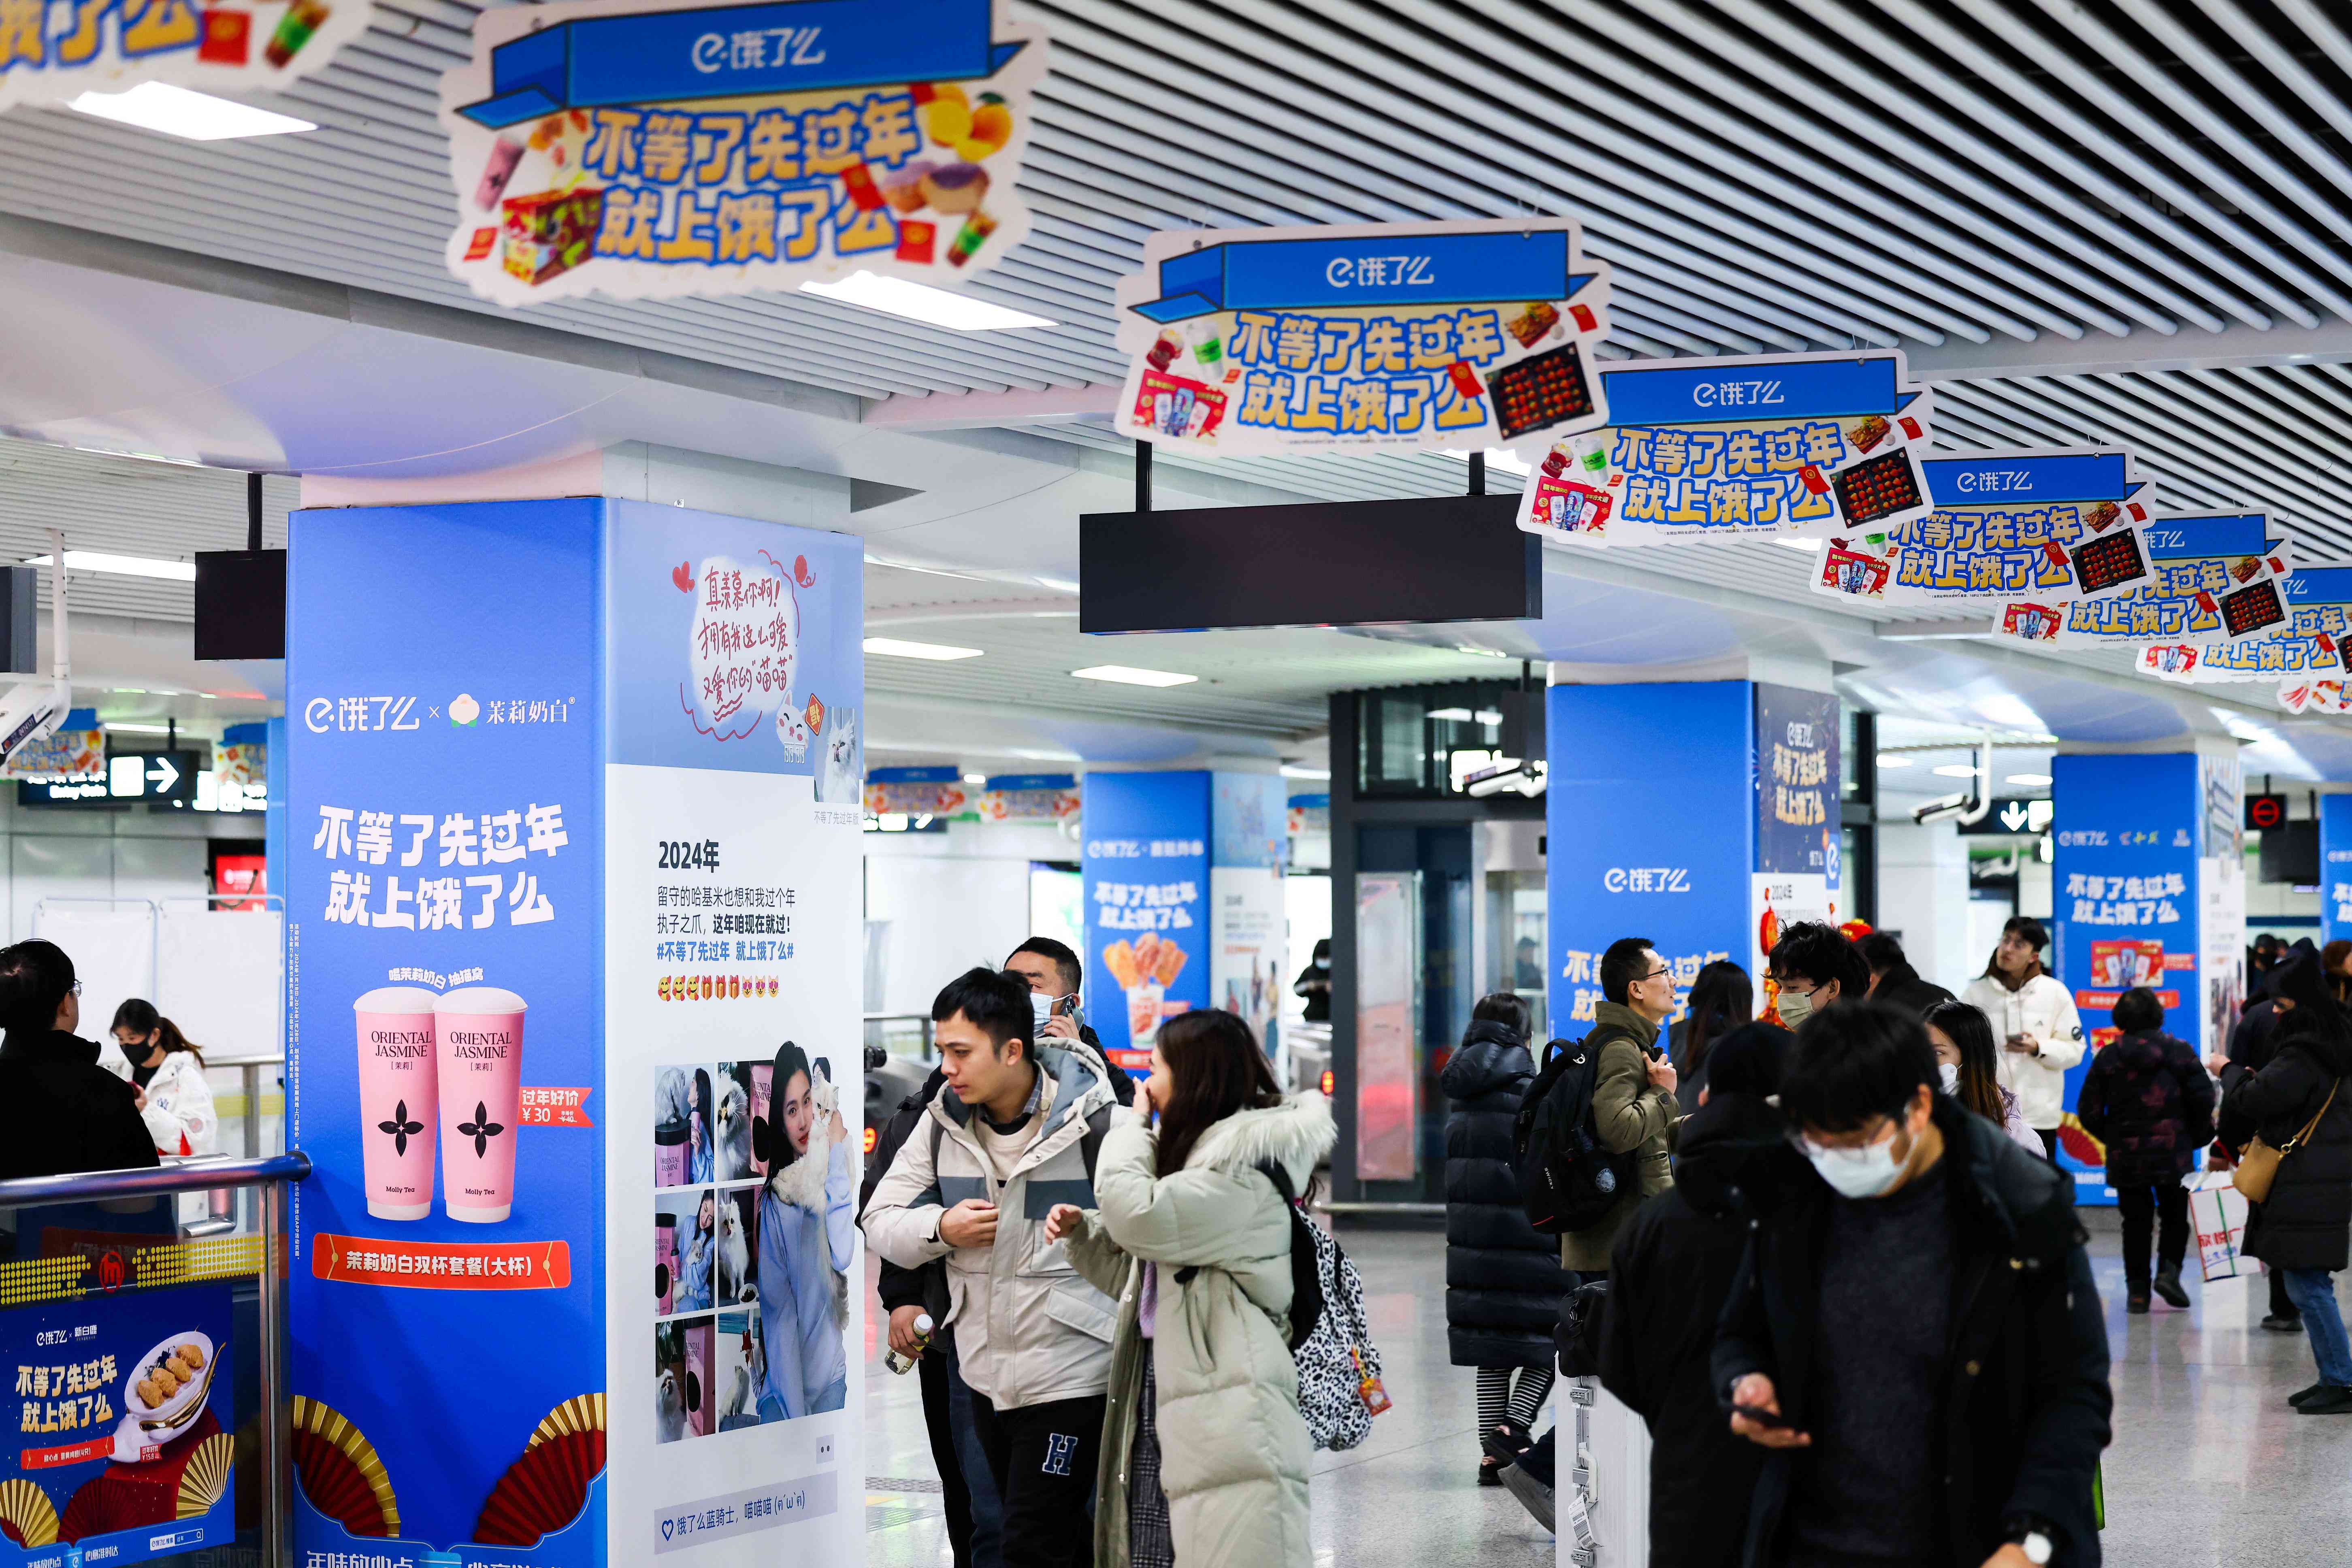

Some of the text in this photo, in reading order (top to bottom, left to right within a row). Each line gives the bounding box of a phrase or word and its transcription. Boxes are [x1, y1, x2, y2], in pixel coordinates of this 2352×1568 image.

[582, 92, 924, 183] 不等了先过年
[593, 180, 901, 267] 就上饿了么
[1227, 308, 1506, 373] 不等了先过年
[1239, 367, 1488, 435] 就上饿了么
[1611, 423, 1848, 476] 不等了先过年
[1621, 472, 1834, 528] 就上饿了么
[1897, 549, 2074, 593] 就上饿了么
[698, 612, 788, 660] 拥有我这么可爱
[313, 803, 569, 867] 不等了先过年
[814, 810, 859, 826] 不等了先过年版
[658, 839, 720, 873] 2024年
[324, 870, 555, 932] 就上饿了么
[658, 886, 795, 908] 留守的哈基米也想和我过个年
[657, 941, 794, 962] #不等了先过年 就上饿了么#
[389, 967, 484, 990] 喝茉莉奶白 抽猫窝
[371, 1031, 432, 1045] ORIENTAL
[375, 1044, 428, 1058] JASMINE
[450, 1032, 513, 1046] ORIENTAL
[454, 1045, 508, 1059] JASMINE
[522, 1089, 579, 1106] 过年好价
[386, 1186, 403, 1194] Molly
[465, 1188, 483, 1197] Molly
[346, 1251, 532, 1278] 茉莉奶白双杯套餐(大杯)
[16, 1354, 118, 1398] 不等了先过年
[21, 1392, 113, 1433] 就上饿了么
[1042, 1432, 1078, 1476] H
[85, 1545, 119, 1562] 心意准时达
